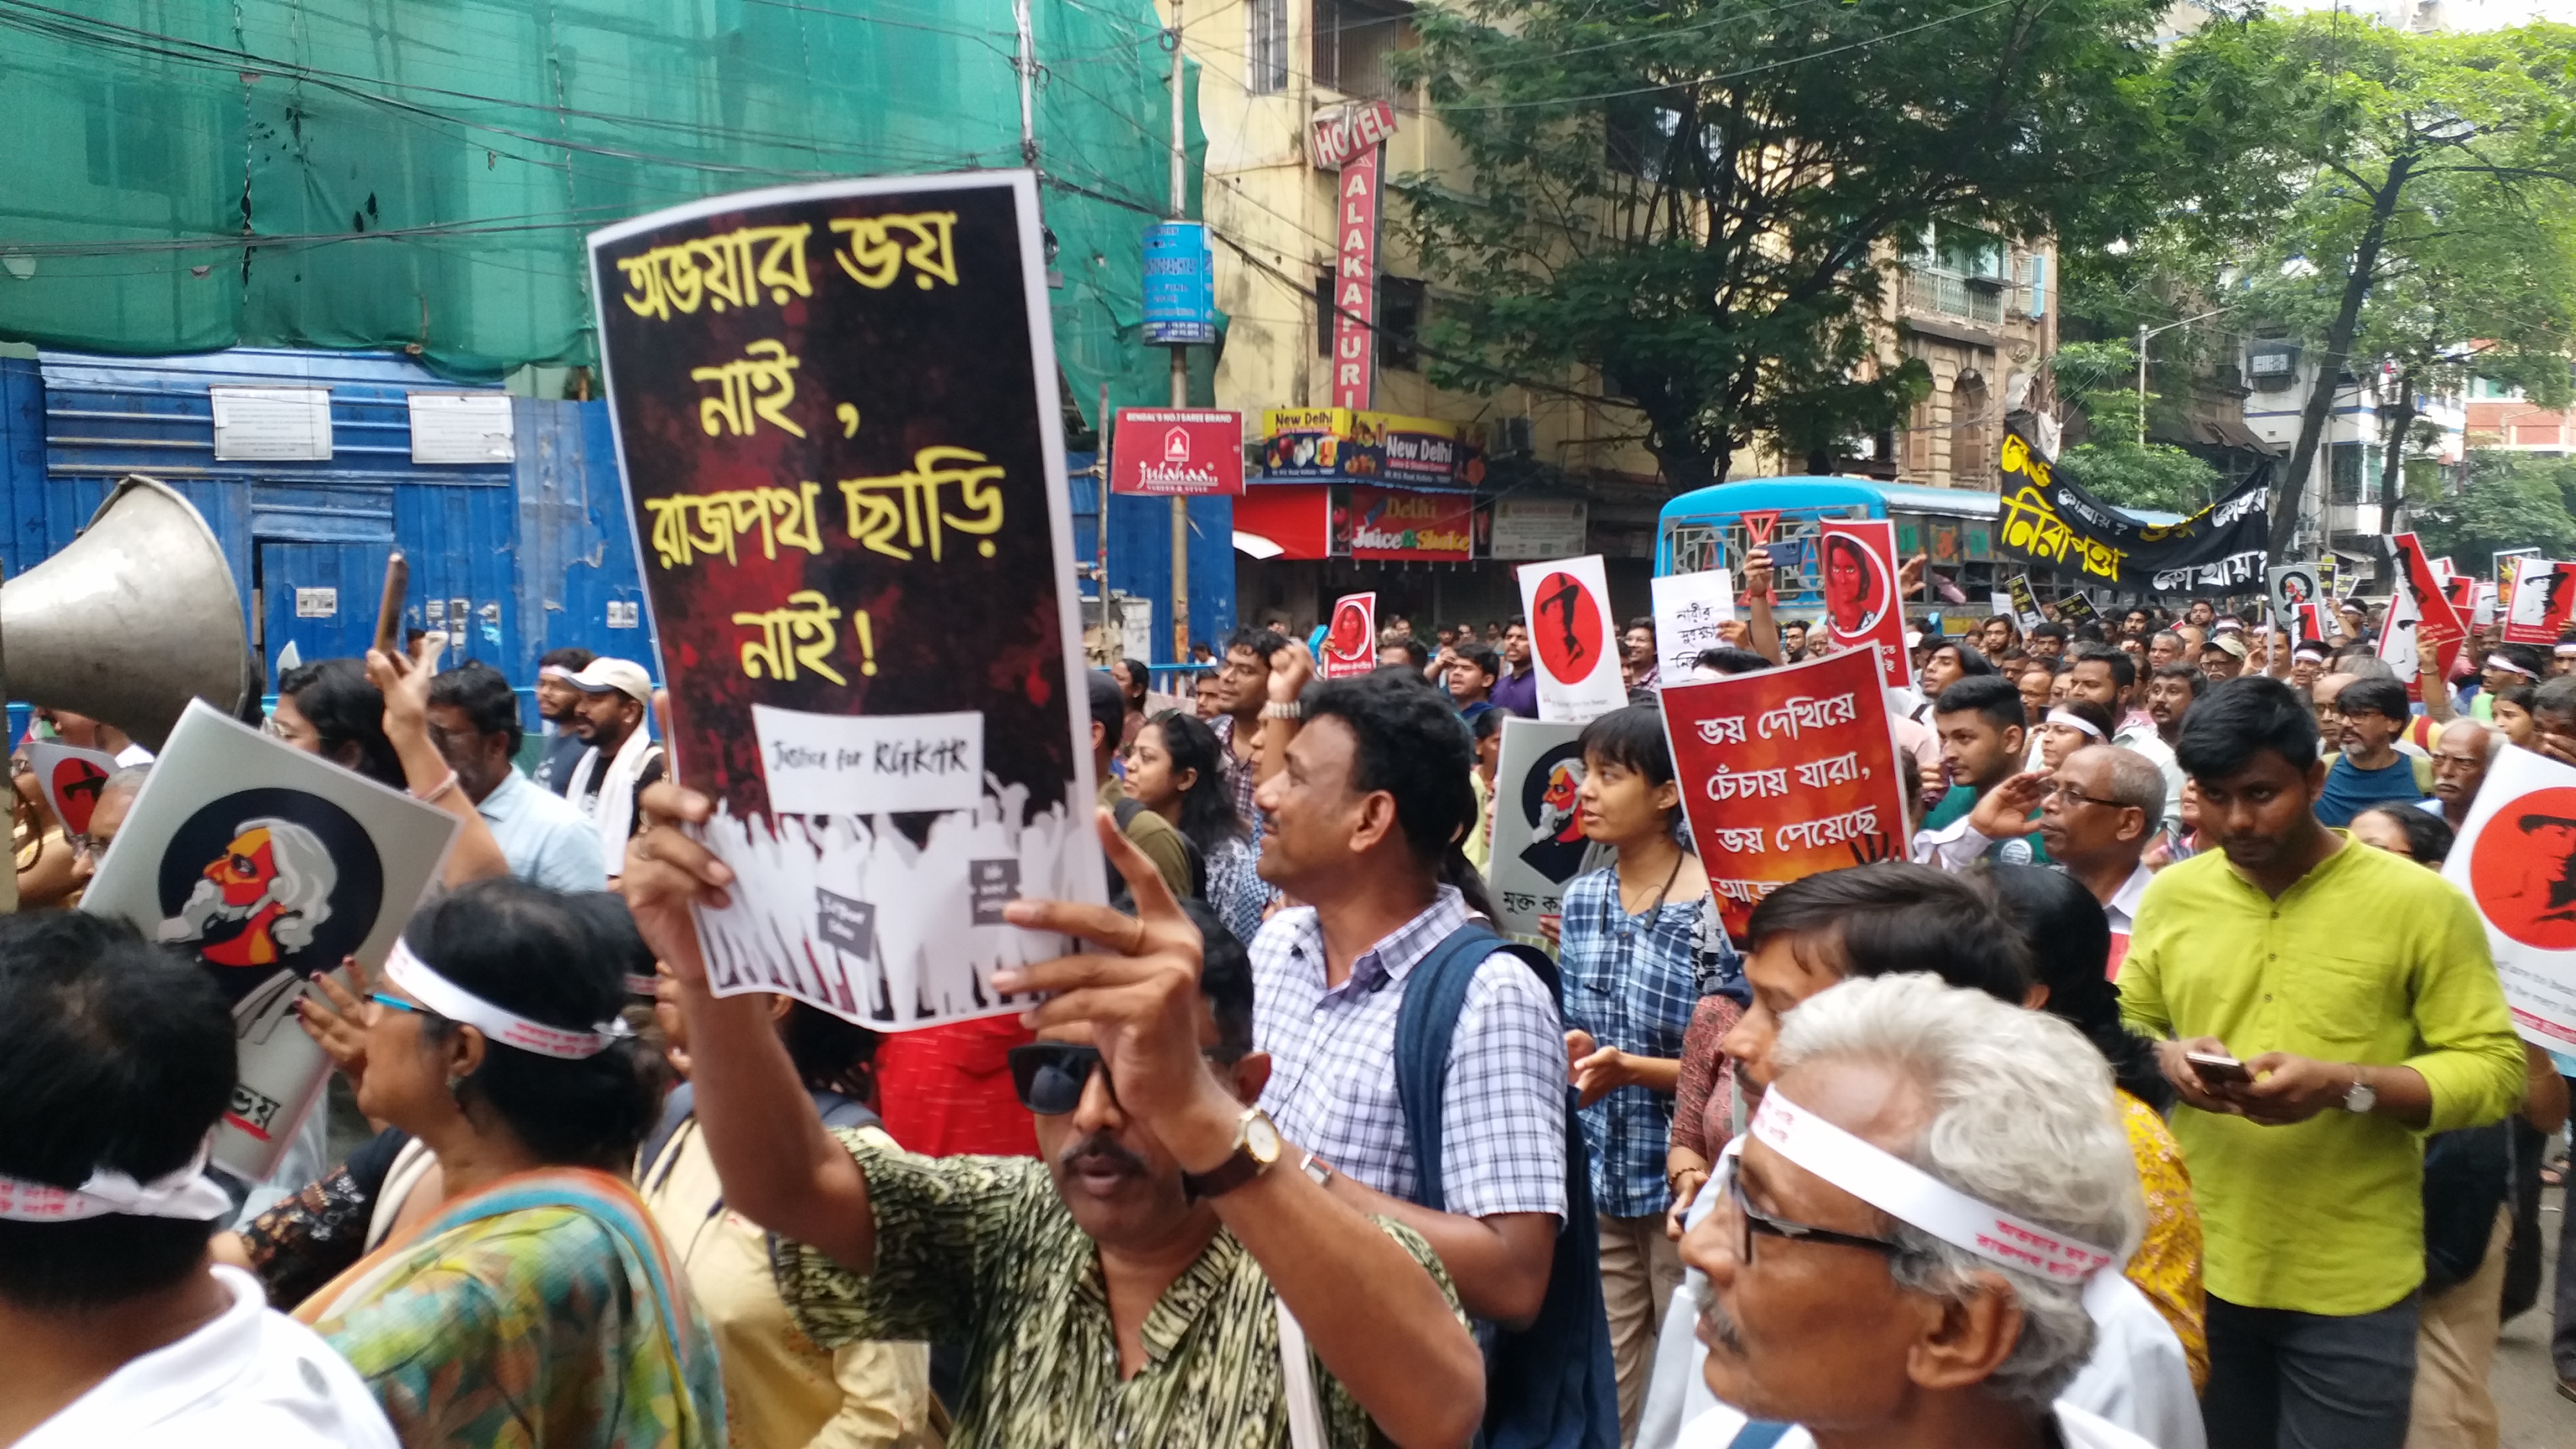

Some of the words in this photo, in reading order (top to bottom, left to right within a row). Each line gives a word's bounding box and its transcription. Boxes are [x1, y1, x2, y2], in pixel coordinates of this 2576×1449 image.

[1315, 106, 1394, 166] HOTEL
[617, 224, 813, 322] অভয়ার
[829, 210, 958, 291] ভয়
[1340, 174, 1368, 409] ALAKAPURI
[692, 338, 807, 439] নাই
[1205, 414, 1233, 424] BRAND
[1275, 412, 1301, 427] New
[1305, 411, 1333, 425] Delhi
[1386, 434, 1418, 460] New
[1420, 438, 1453, 463] Delhi
[645, 481, 824, 570] রাজপথ
[838, 446, 1006, 562] ছাড়ি
[1352, 525, 1403, 550] Juice
[1694, 715, 1748, 745] ভয়
[1757, 692, 1857, 741] দেখিয়ে
[770, 740, 827, 773] Justice
[837, 752, 864, 773] for
[1706, 763, 1789, 802] চেঁচায়
[1794, 750, 1871, 789] যারা,
[1715, 827, 1766, 855] ভয়
[1775, 804, 1882, 852] পেয়েছে
